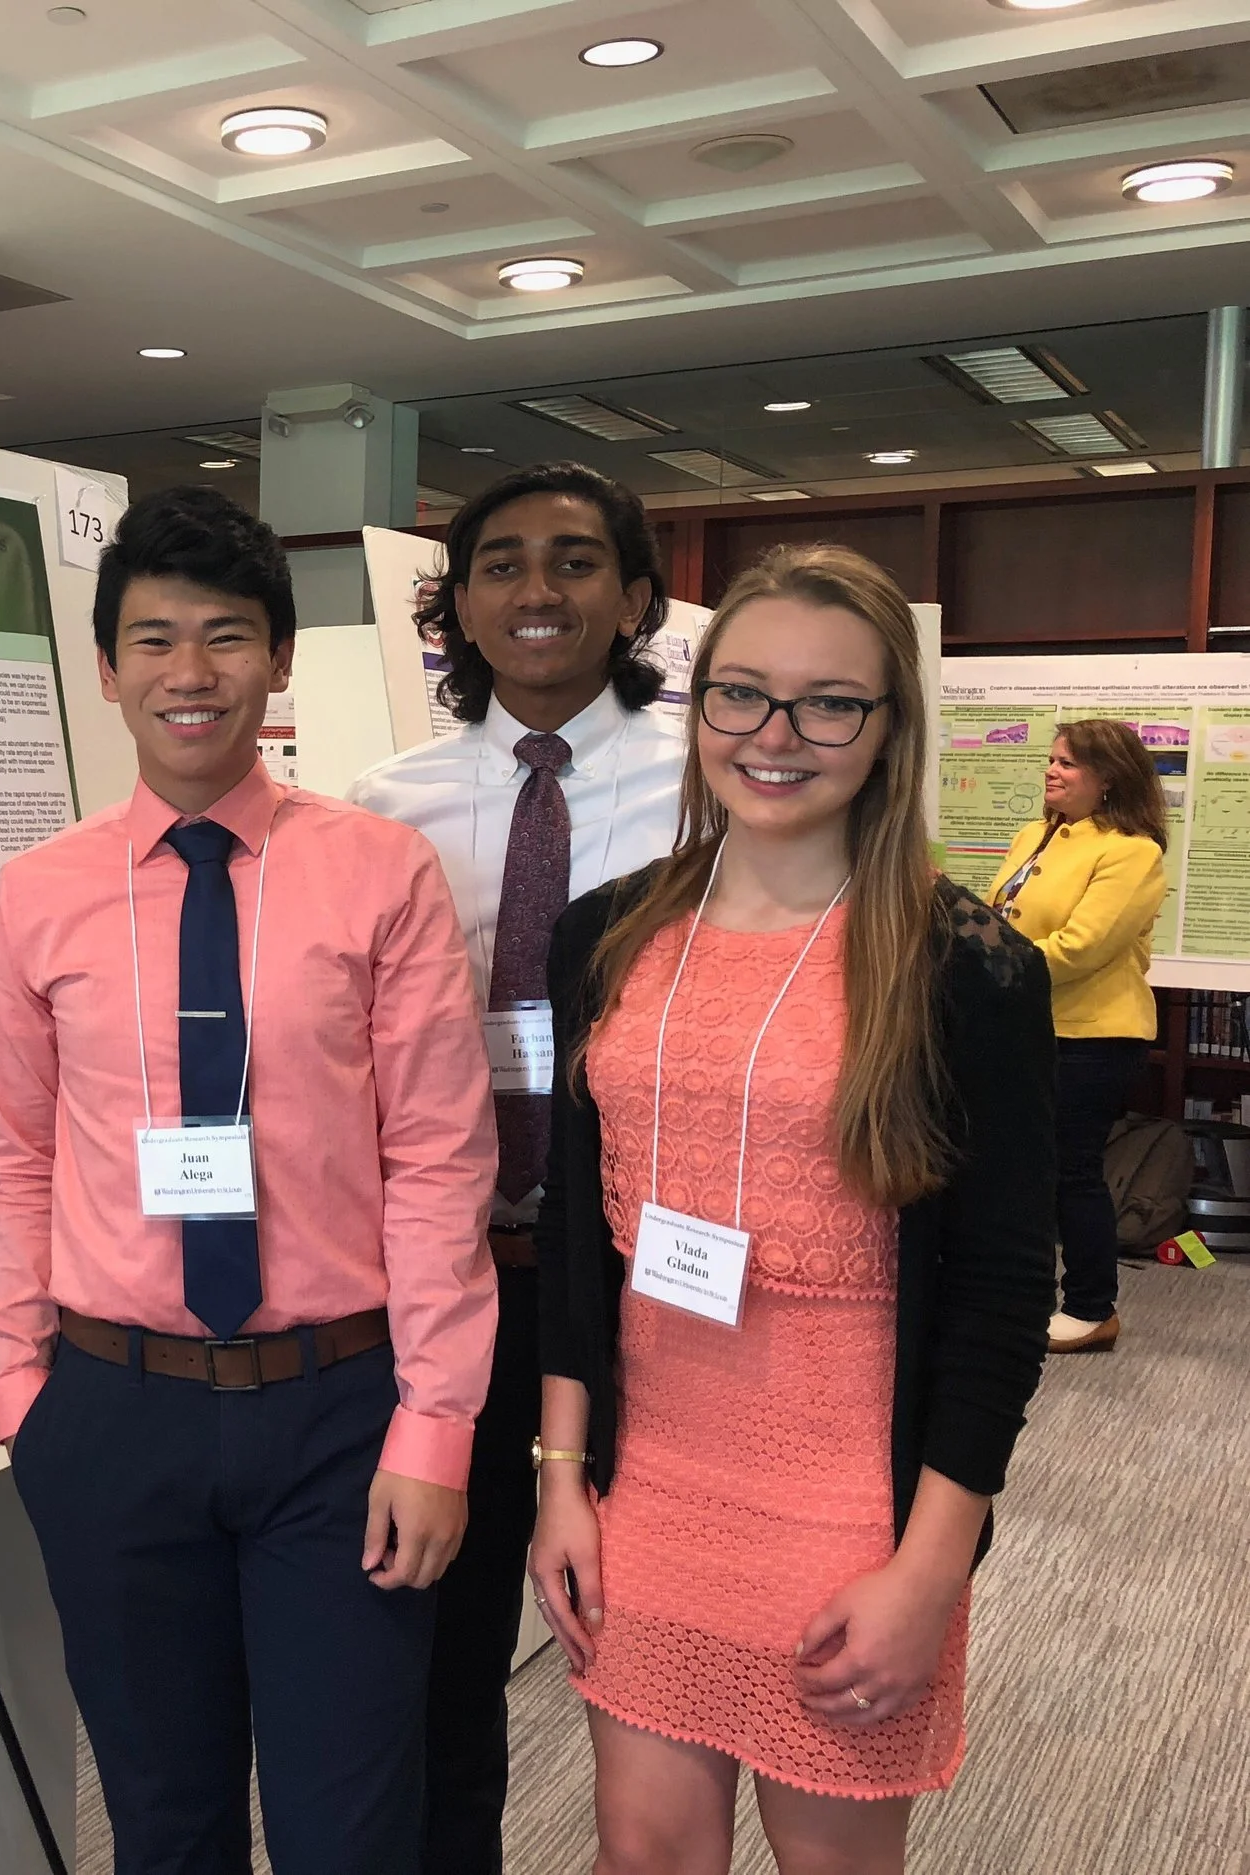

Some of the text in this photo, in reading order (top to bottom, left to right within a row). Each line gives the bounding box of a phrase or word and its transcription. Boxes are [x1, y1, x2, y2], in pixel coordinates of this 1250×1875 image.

[69, 509, 103, 542] 173
[942, 685, 986, 695] Washington
[180, 1153, 209, 1163] Juan
[180, 1169, 213, 1182] Alega
[675, 1239, 708, 1261] Vlada
[666, 1256, 709, 1279] Gladun
